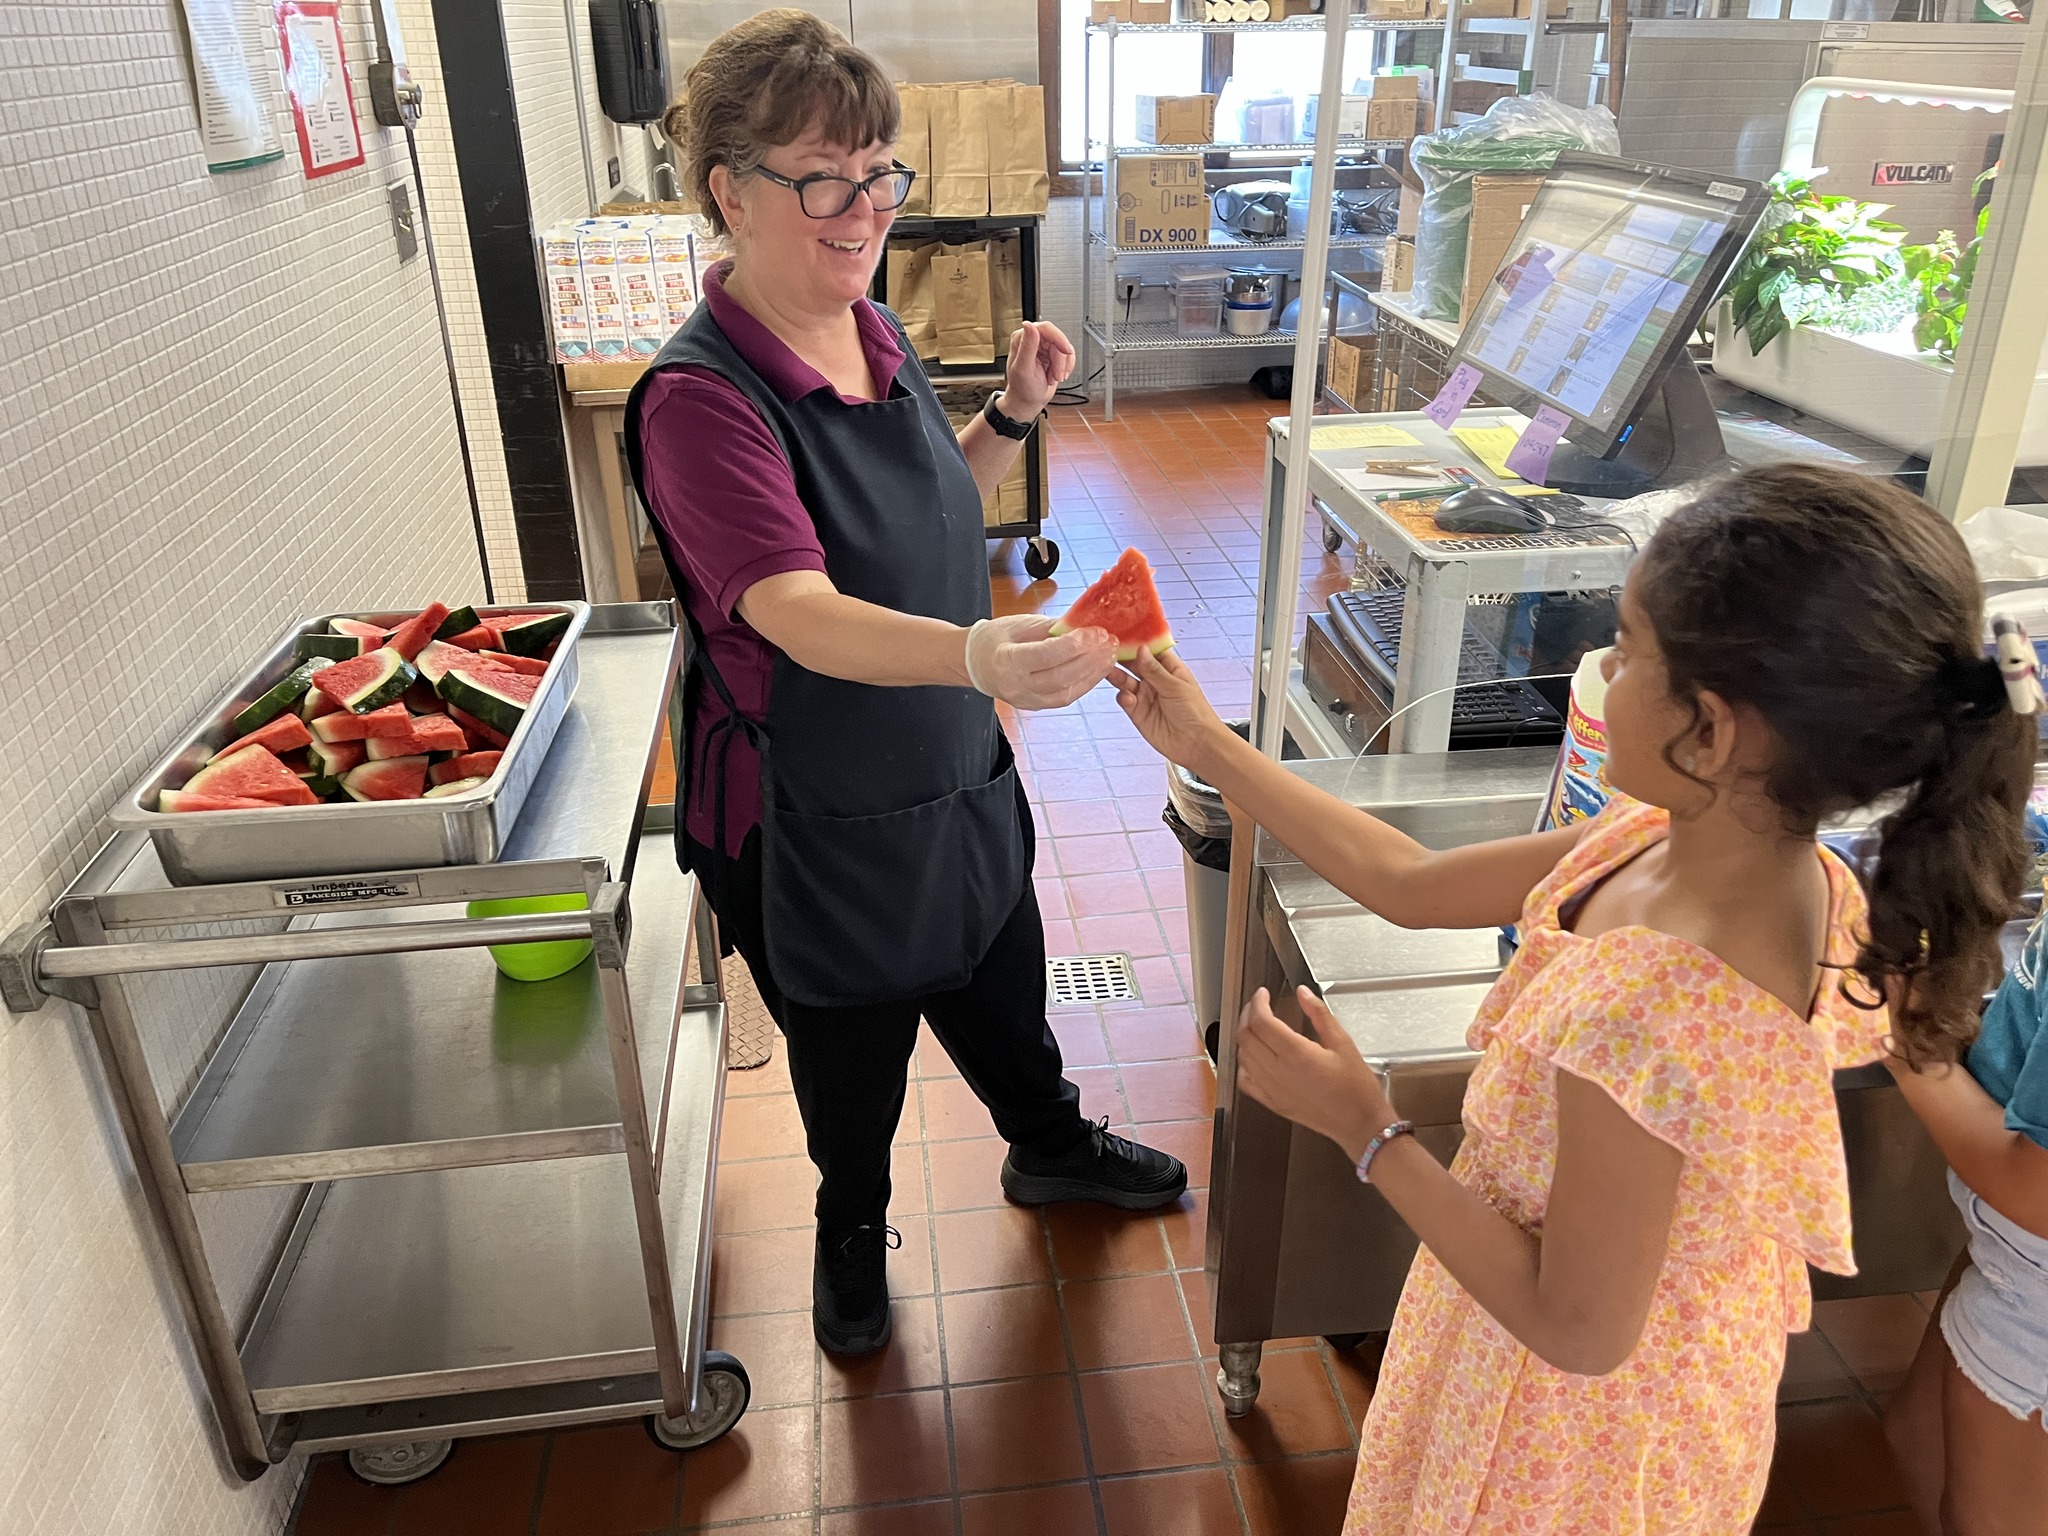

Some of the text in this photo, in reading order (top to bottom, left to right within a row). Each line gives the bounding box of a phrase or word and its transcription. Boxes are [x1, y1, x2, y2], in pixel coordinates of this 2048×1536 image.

[1885, 165, 1947, 183] VULCAN
[1139, 228, 1197, 243] DX 900
[1437, 536, 1577, 552] Steelers
[312, 881, 368, 892] Imperia
[305, 891, 353, 900] LAKESIDE
